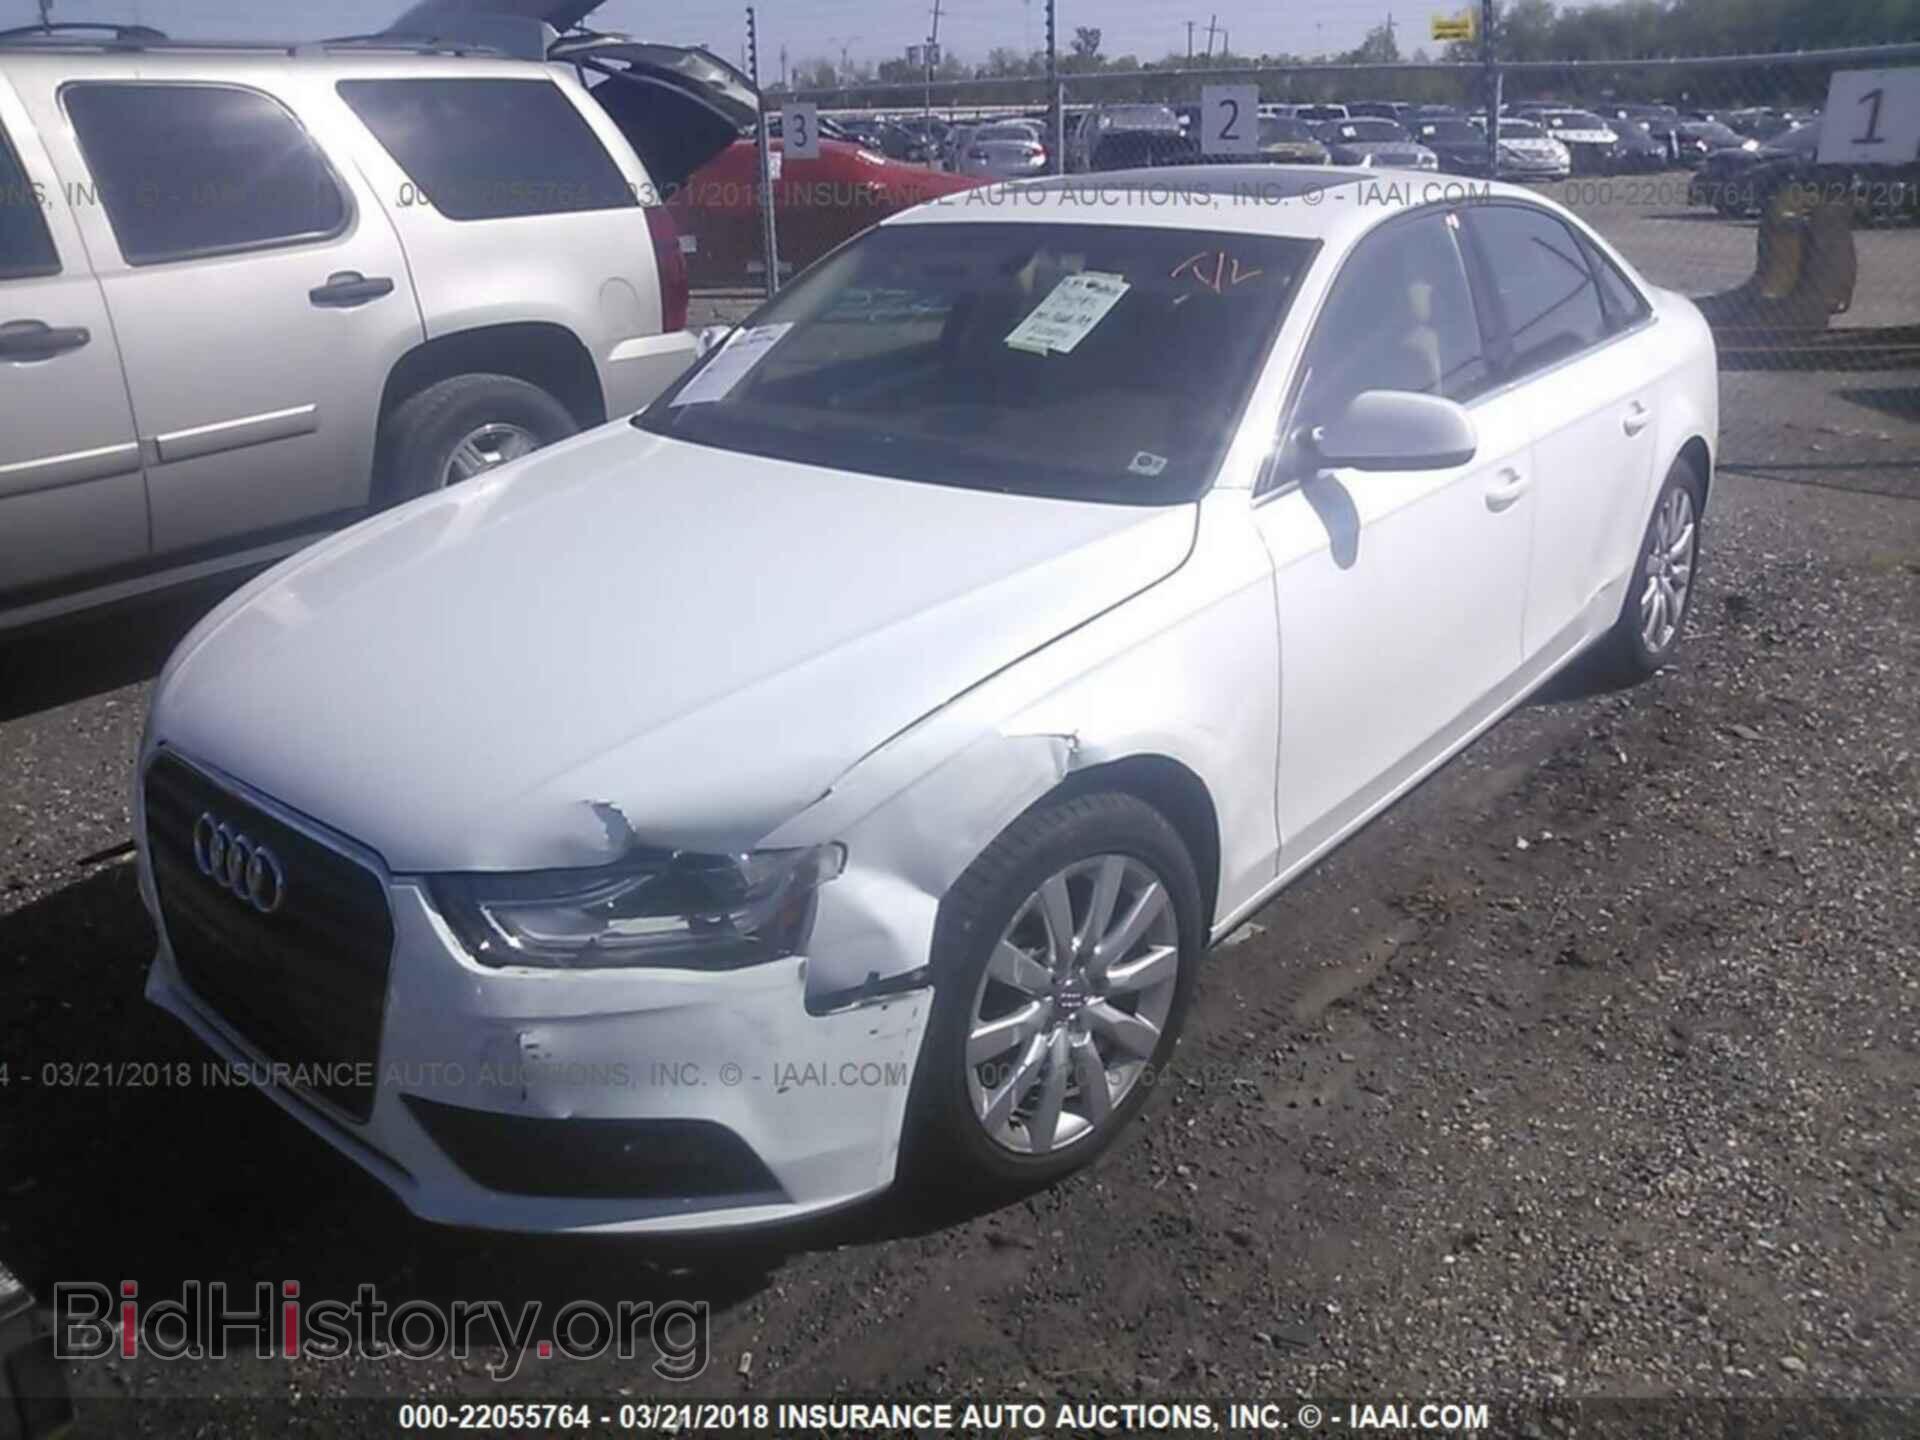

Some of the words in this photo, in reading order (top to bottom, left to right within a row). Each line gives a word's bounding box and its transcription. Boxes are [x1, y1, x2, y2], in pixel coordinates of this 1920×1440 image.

[792, 113, 808, 148] 3
[1219, 98, 1240, 140] 2
[1850, 88, 1886, 145] 1
